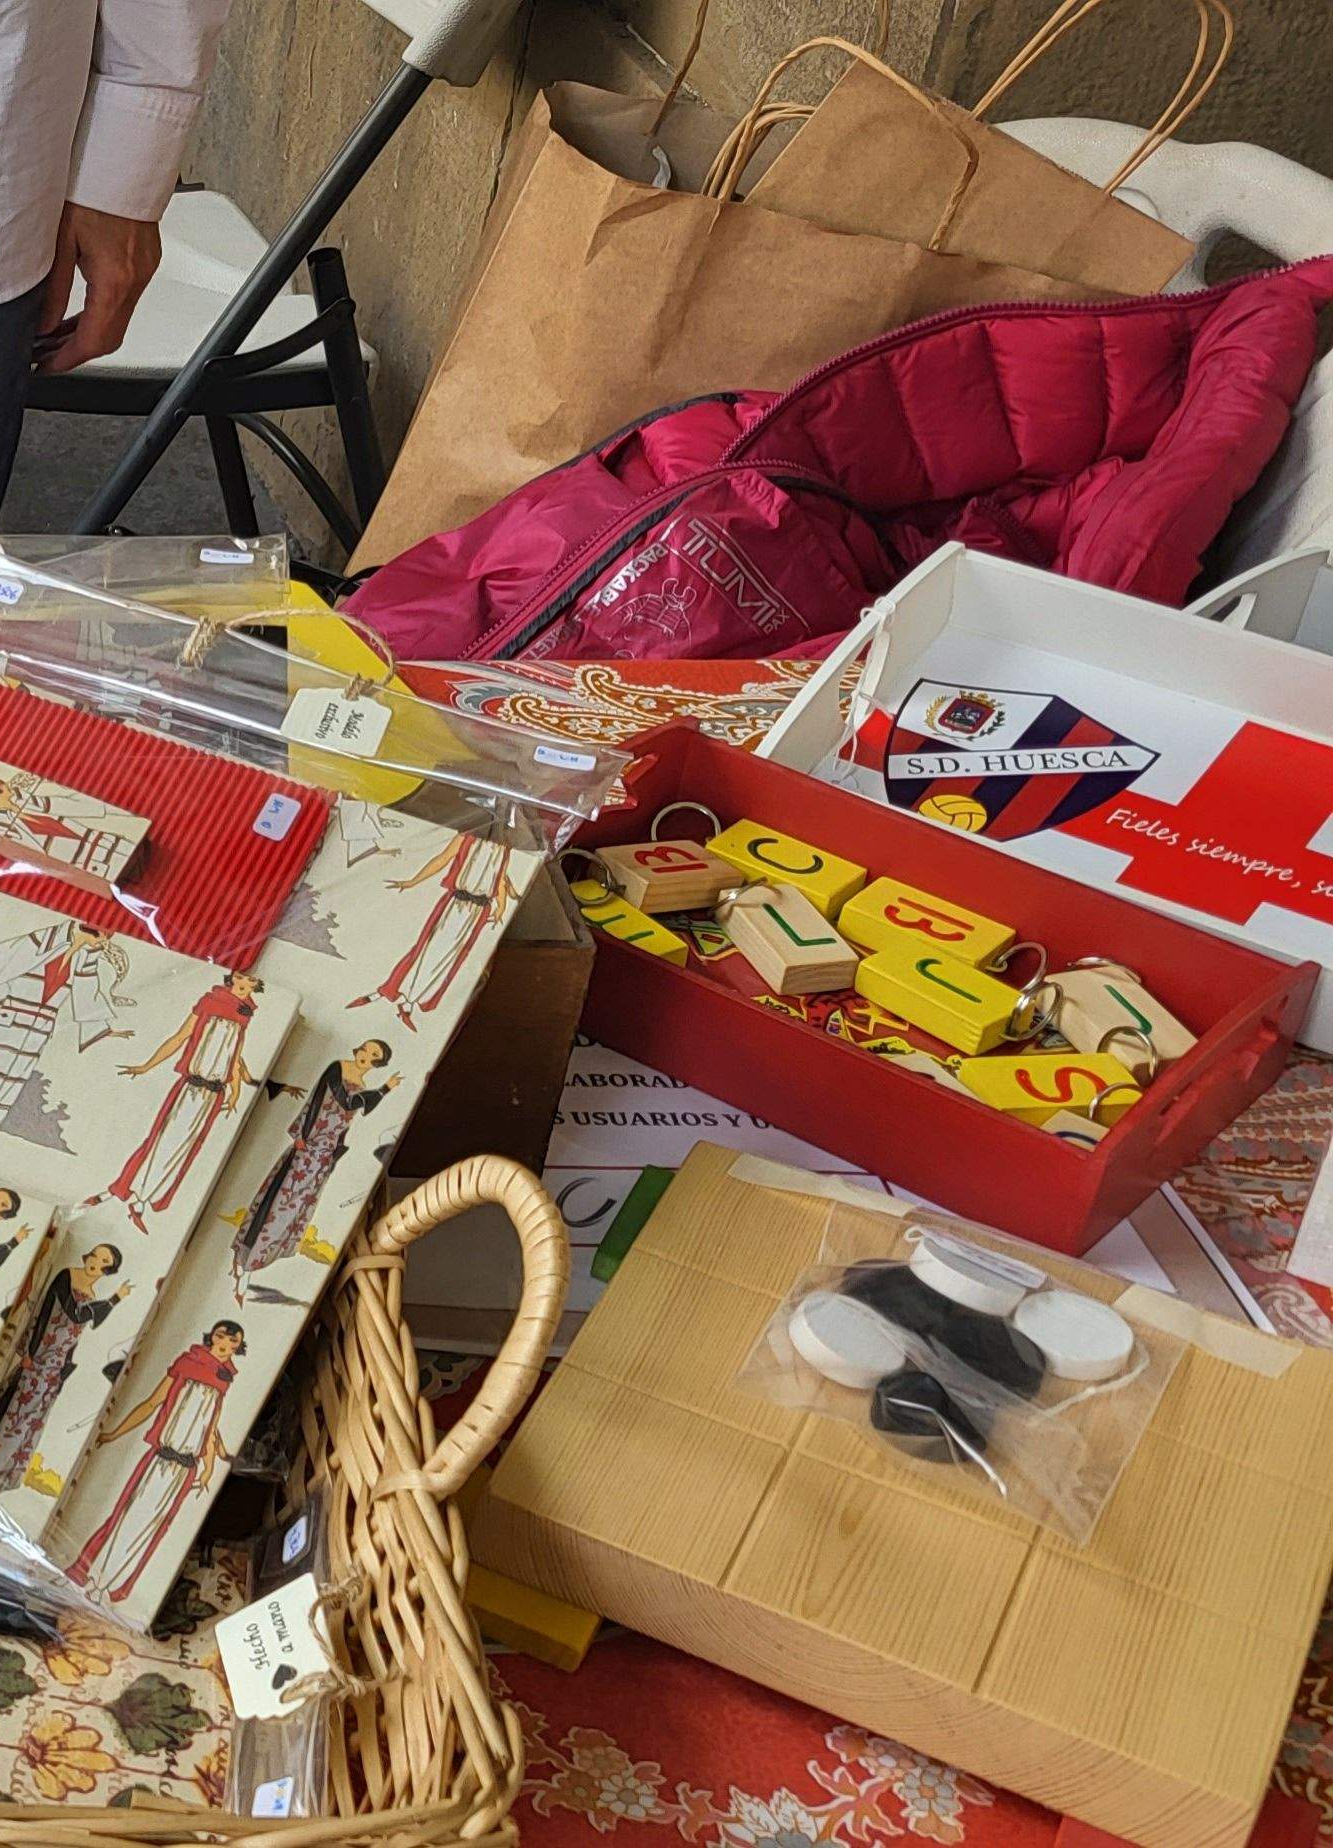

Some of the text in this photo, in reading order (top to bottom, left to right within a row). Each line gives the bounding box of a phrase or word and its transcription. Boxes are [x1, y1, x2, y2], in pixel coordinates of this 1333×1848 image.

[683, 518, 779, 628] TUMI
[906, 749, 1132, 776] S.D. HUESCA
[1105, 809, 1180, 847] Fieles
[1185, 837, 1302, 890] siempre,
[1014, 1066, 1108, 1103] S
[570, 1111, 719, 1127] USUARIOS
[722, 1113, 742, 1128] Y
[245, 1622, 271, 1671] Hecho
[267, 1601, 294, 1653] mano a
